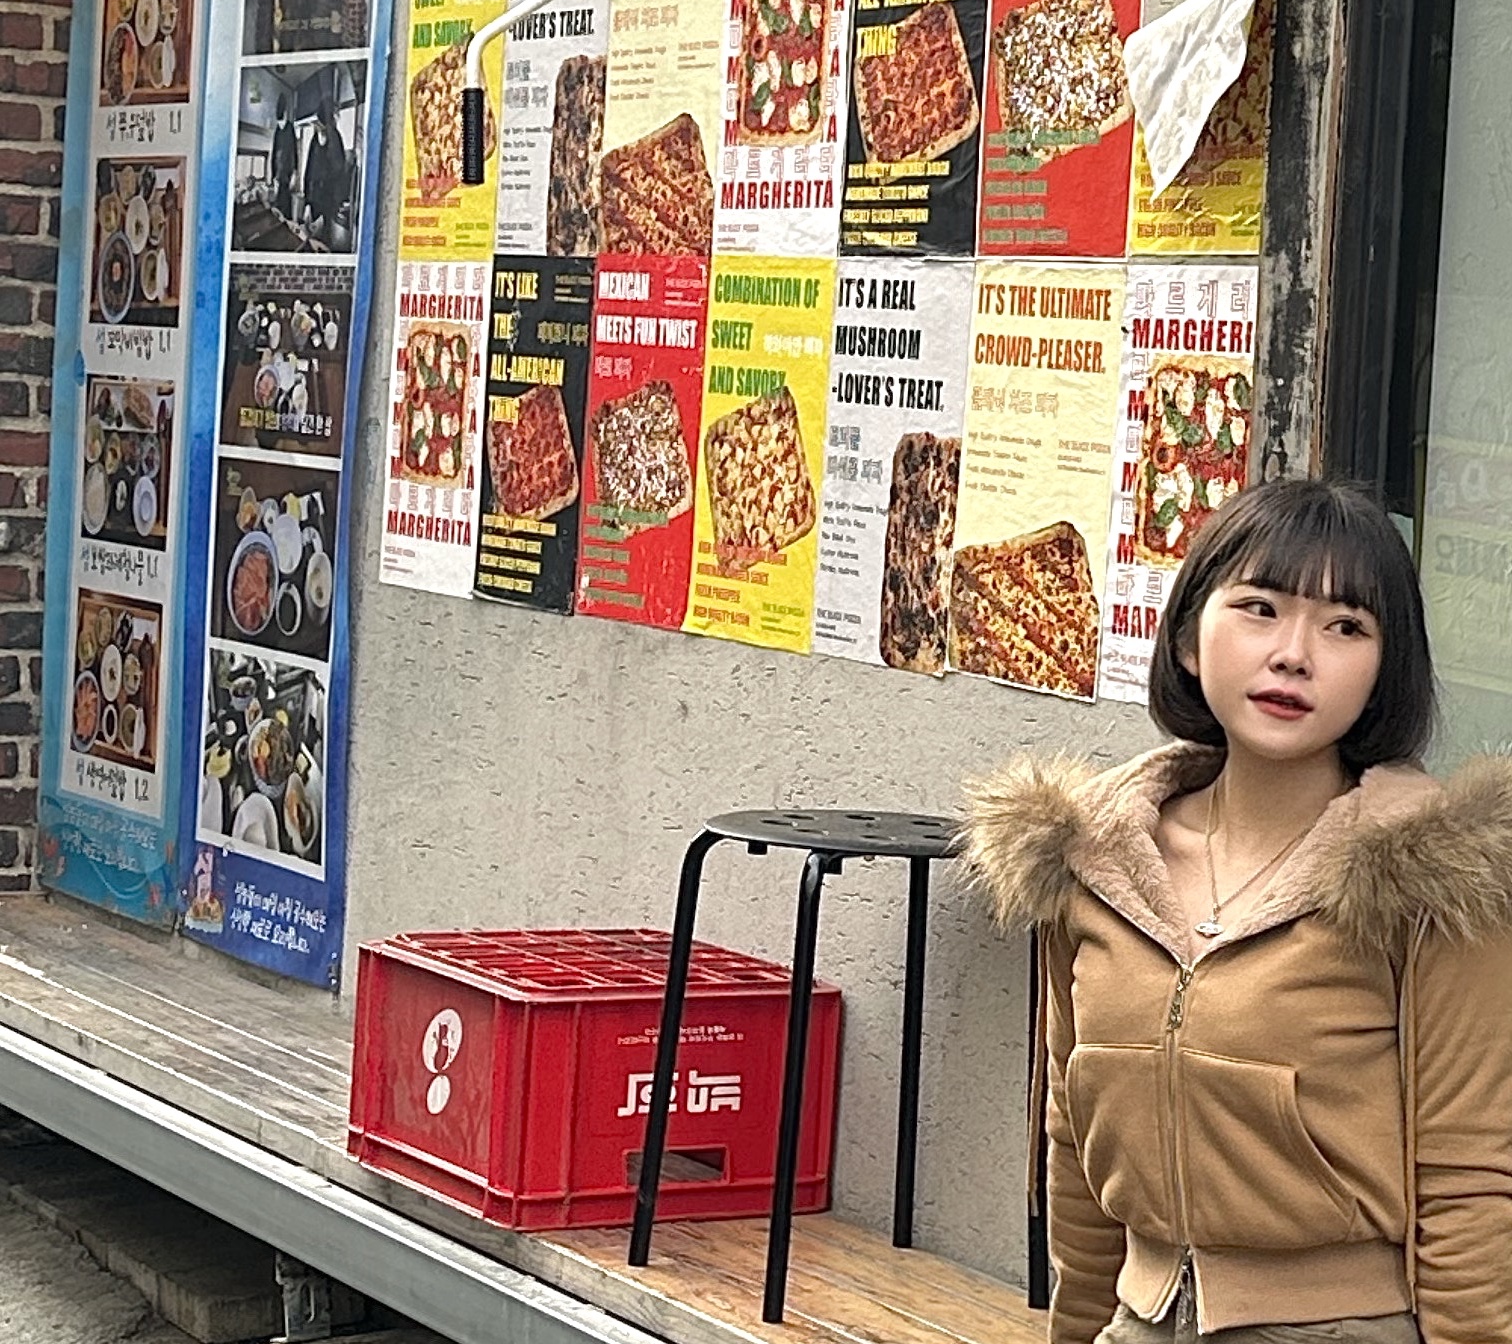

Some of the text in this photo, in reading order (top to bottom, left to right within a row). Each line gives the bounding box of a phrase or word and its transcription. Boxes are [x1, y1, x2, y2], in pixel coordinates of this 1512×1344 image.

[856, 24, 900, 58] THING
[720, 178, 834, 210] MARGHERITA
[599, 271, 649, 301] MEXICAN
[714, 274, 819, 308] COMBINATION OF
[838, 277, 915, 311] IT'S A REAL
[978, 283, 1112, 321] IT'S THE ULTIMATE
[400, 294, 483, 321] MARGHERITA
[595, 315, 632, 344] MEETS
[634, 317, 656, 346] FUN
[657, 319, 698, 349] TWIST
[712, 320, 753, 351] SWEET
[835, 325, 921, 359] MUSHROOM
[975, 336, 1106, 375] CROWD-PLEASER.
[708, 365, 734, 394] AND
[387, 510, 472, 546] MARGHERITA
